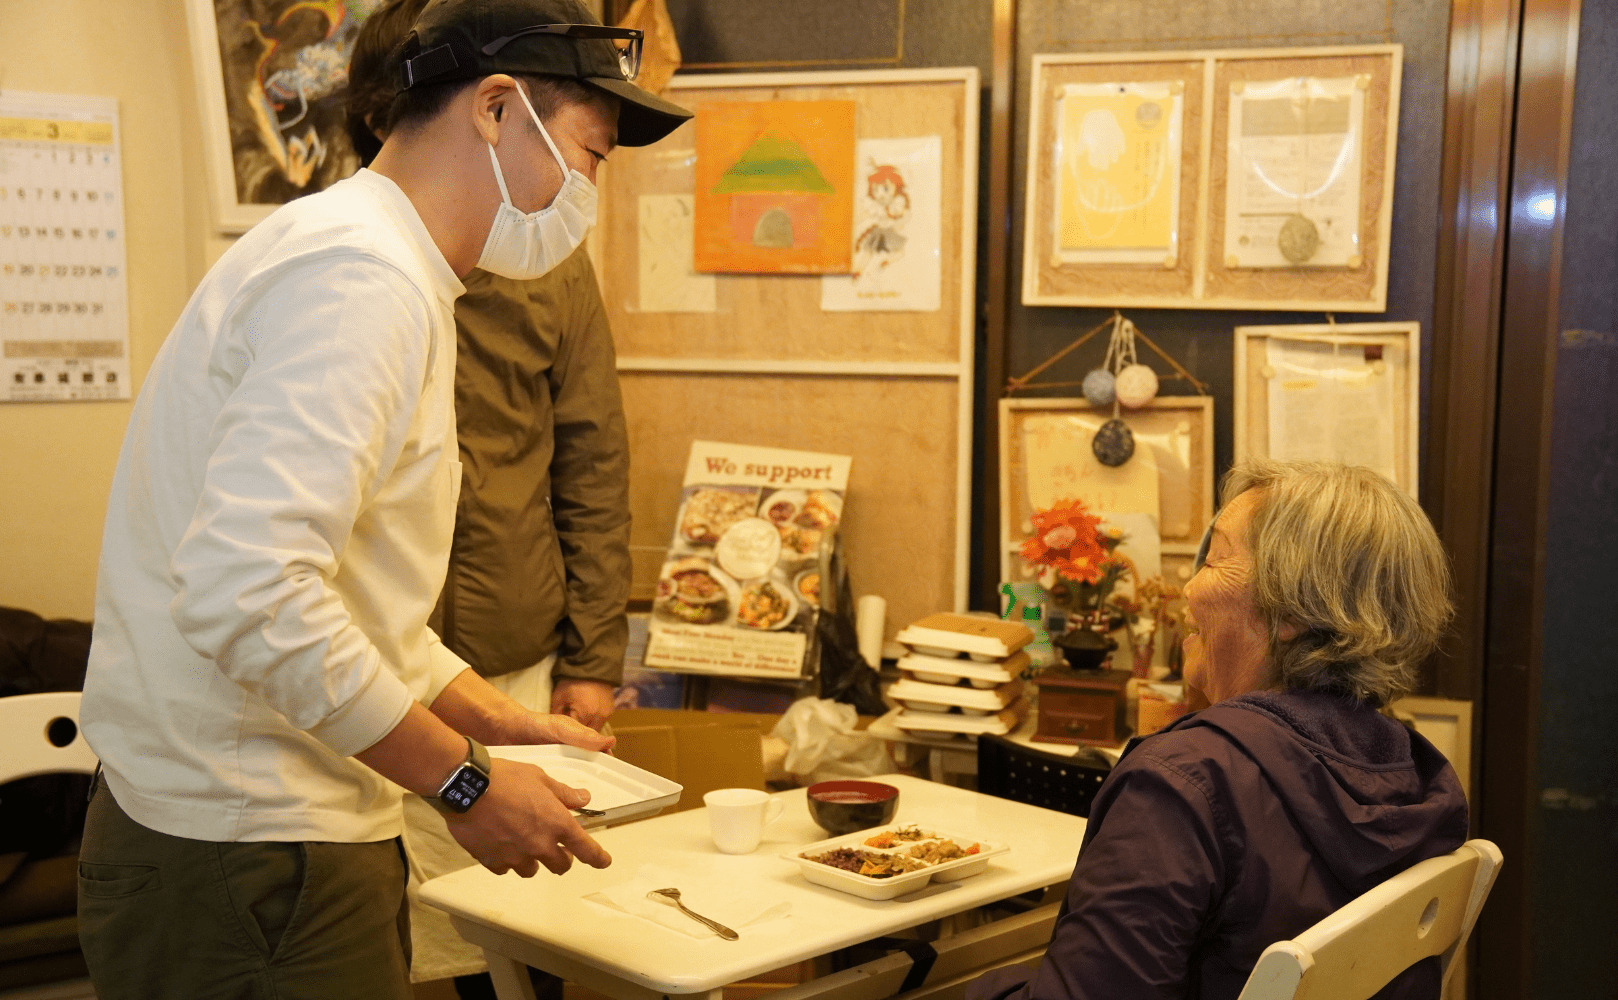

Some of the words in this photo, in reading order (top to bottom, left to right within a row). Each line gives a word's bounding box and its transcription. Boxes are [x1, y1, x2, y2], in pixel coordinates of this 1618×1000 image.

[47, 122, 60, 141] 3
[17, 187, 26, 200] 6
[52, 188, 61, 202] 8
[70, 189, 79, 202] 9
[86, 190, 99, 202] 10
[18, 226, 30, 238] 13
[36, 226, 48, 238] 14
[54, 227, 65, 239] 15
[72, 228, 83, 240] 16
[88, 228, 99, 240] 17
[19, 264, 35, 276] 20
[55, 265, 68, 277] 22
[72, 265, 86, 277] 23
[89, 266, 102, 277] 24
[21, 302, 34, 314] 27
[39, 303, 52, 314] 28
[57, 302, 71, 314] 29
[74, 302, 88, 314] 30
[92, 302, 103, 314] 31
[705, 457, 737, 475] We
[744, 463, 832, 483] support
